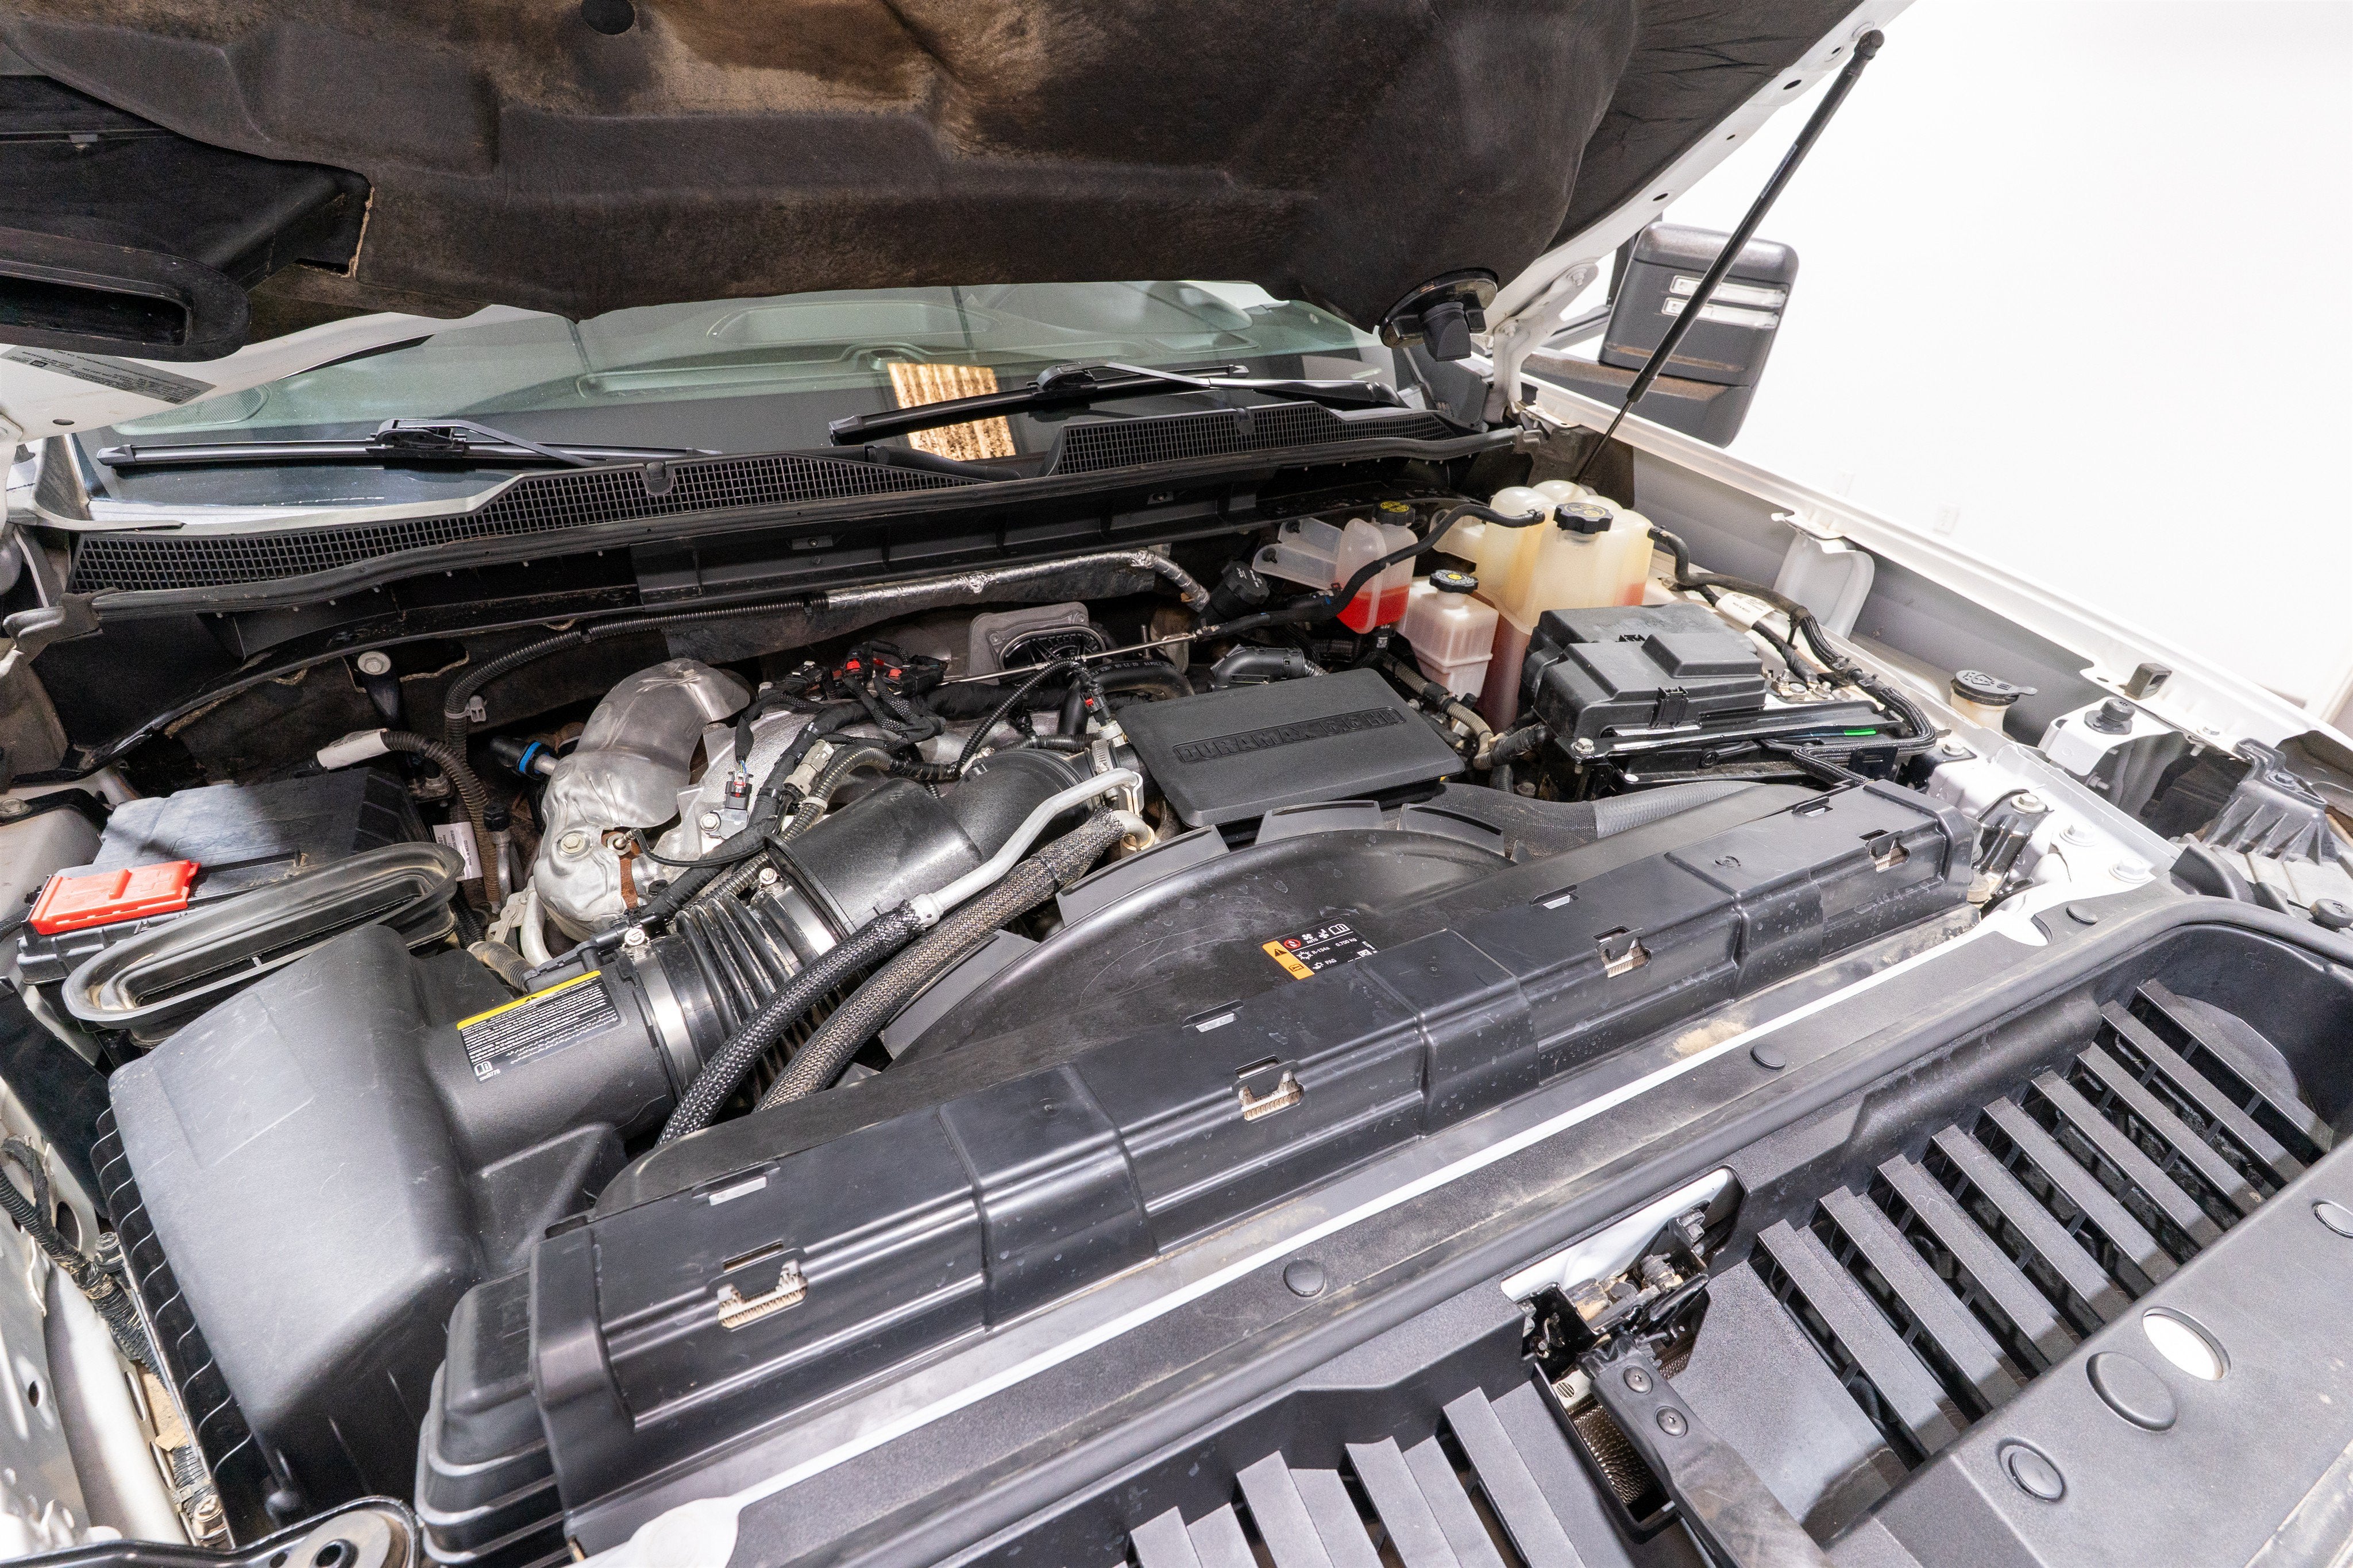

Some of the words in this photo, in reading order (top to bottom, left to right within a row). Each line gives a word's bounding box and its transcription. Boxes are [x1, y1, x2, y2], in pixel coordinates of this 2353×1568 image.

[1175, 726, 1317, 763] DURAMAX
[1321, 716, 1362, 735] 6.6
[1363, 709, 1401, 727] HD
[1311, 946, 1330, 955] R-134a
[1335, 939, 1350, 947] 0.700
